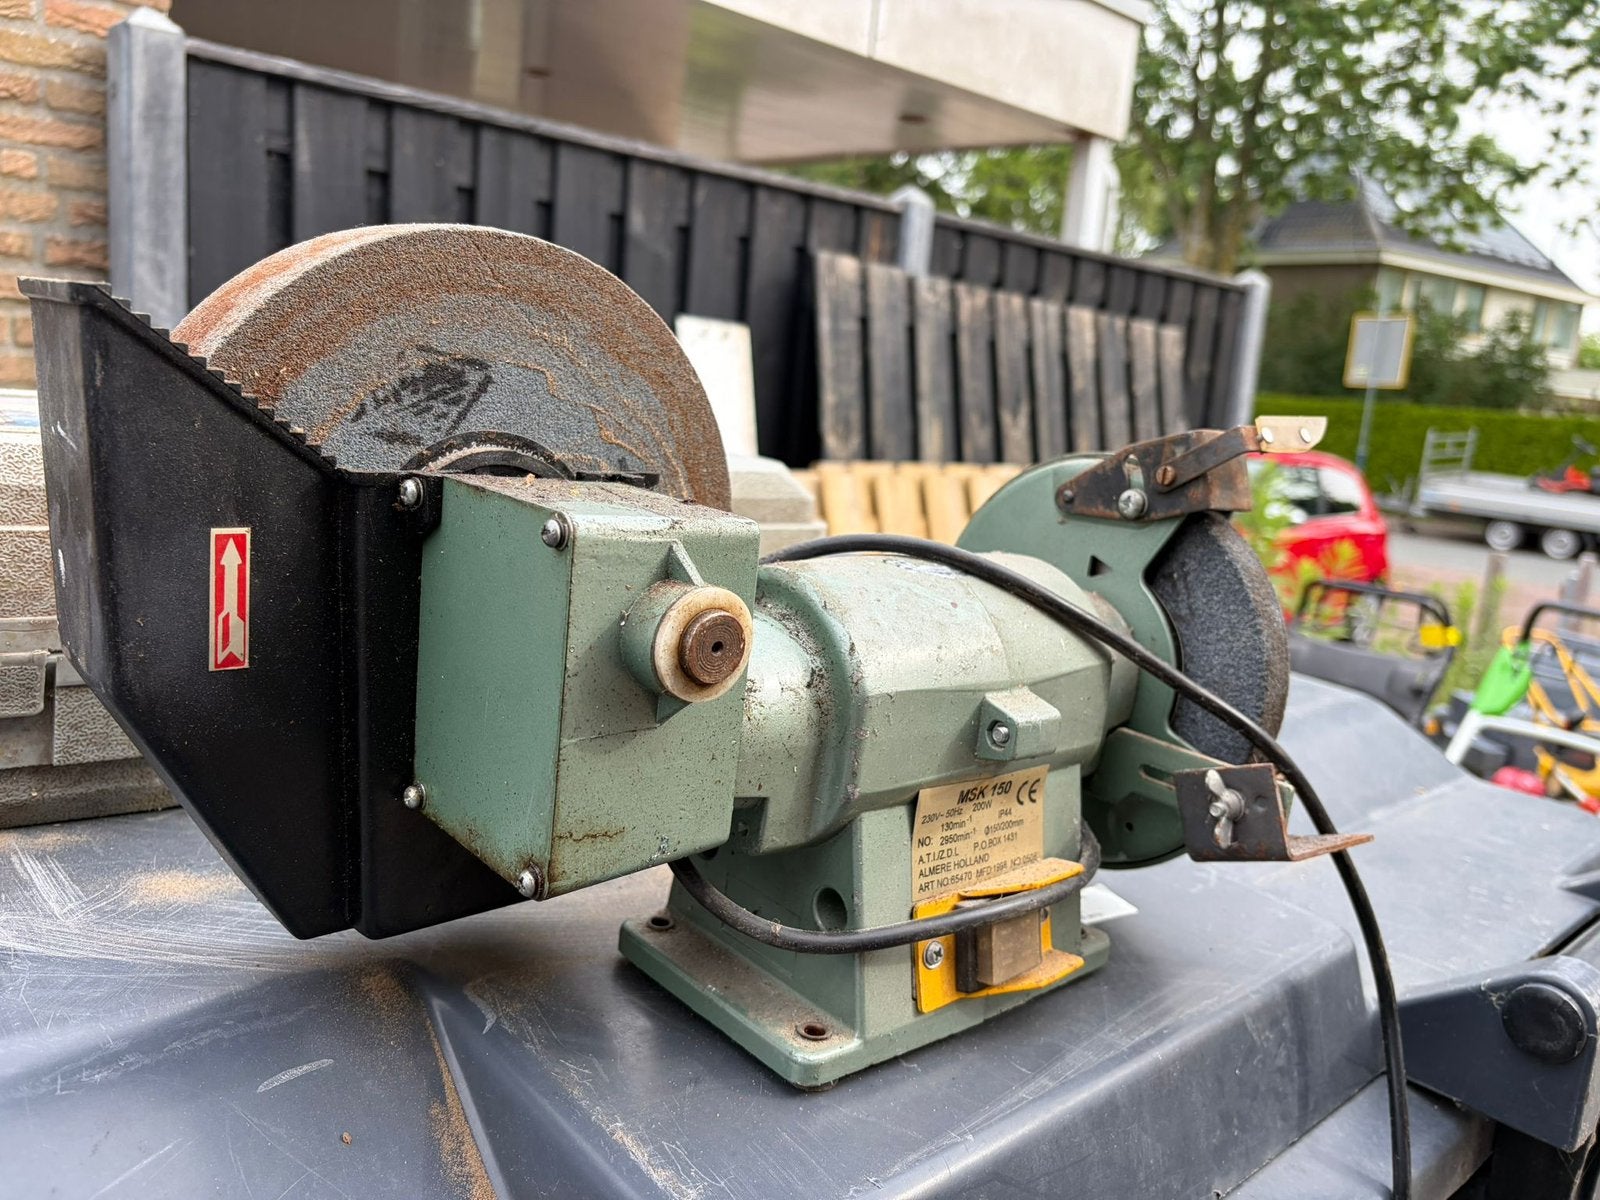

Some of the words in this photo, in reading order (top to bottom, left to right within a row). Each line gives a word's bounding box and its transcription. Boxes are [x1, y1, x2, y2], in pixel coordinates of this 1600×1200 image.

[957, 784, 988, 804] MSK
[990, 780, 1012, 797] 150
[945, 807, 963, 818] 50Hz
[972, 799, 992, 812] 200W
[998, 808, 1012, 818] IP44
[1003, 832, 1018, 843] 1431
[918, 861, 952, 879] ALMERE
[953, 852, 990, 870] HOLLAND
[918, 879, 935, 893] ART
